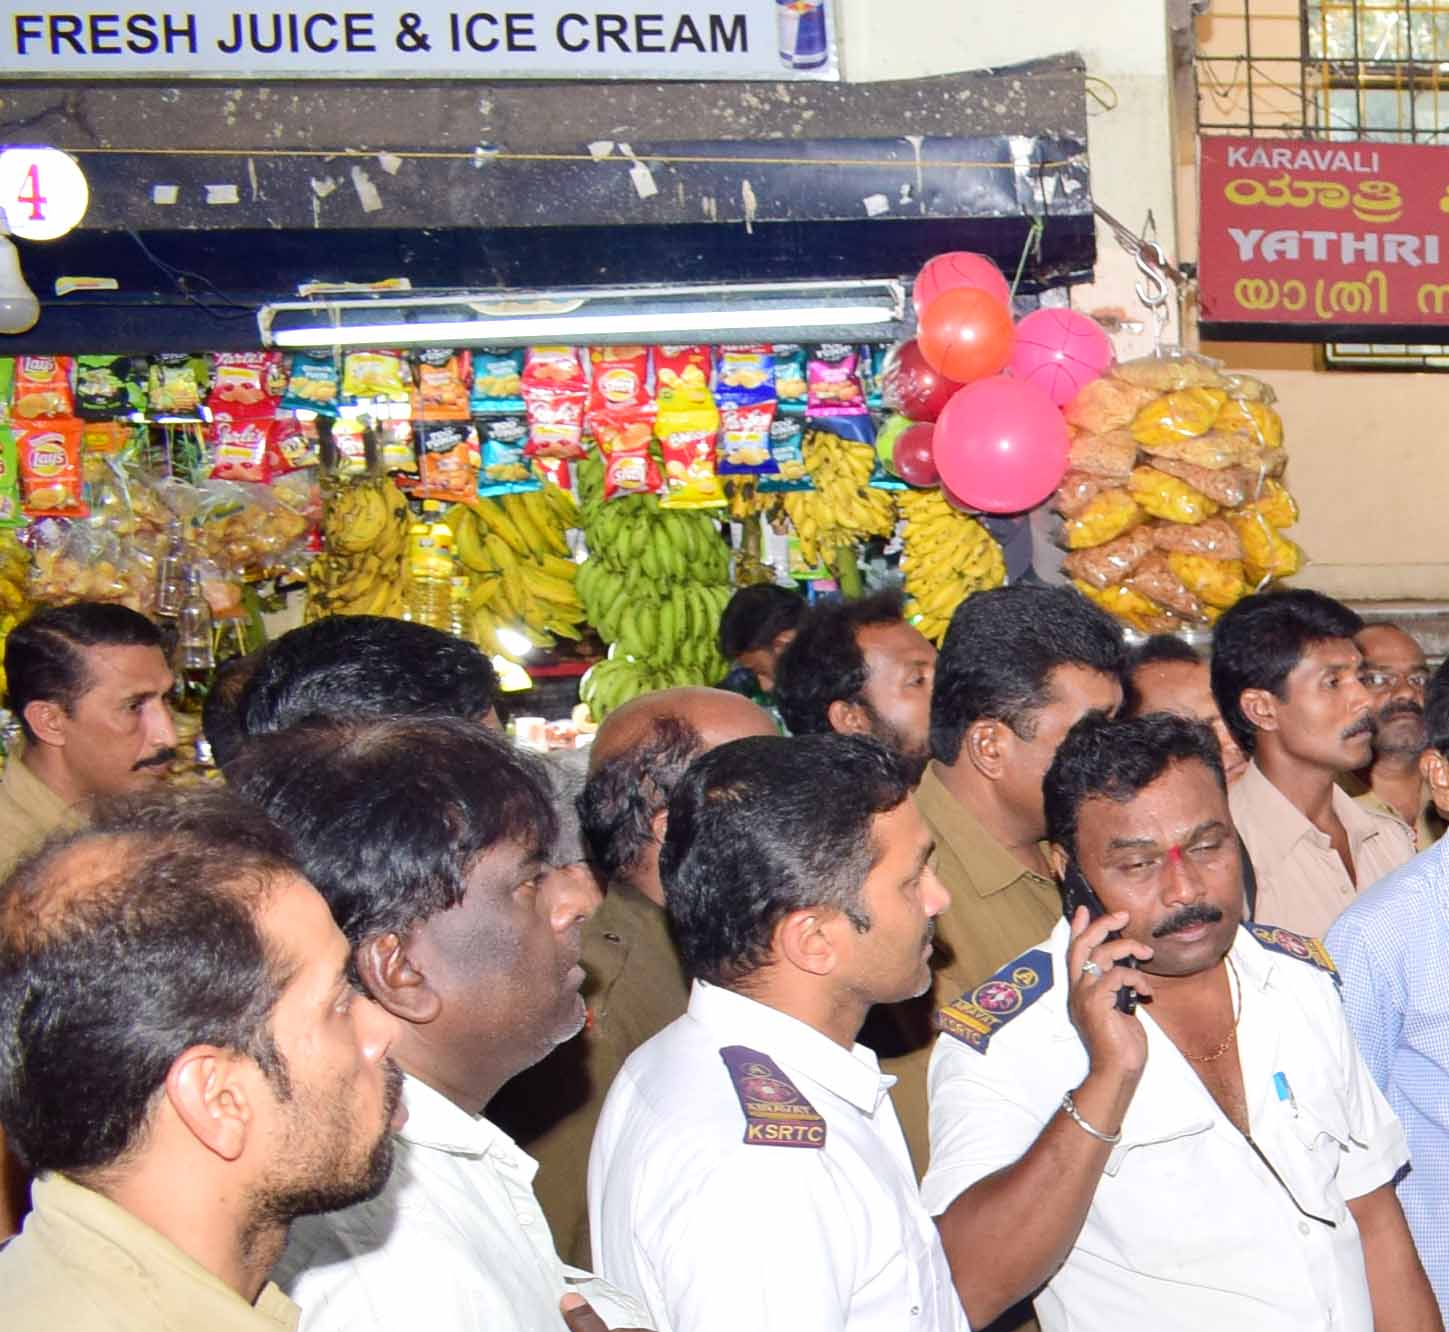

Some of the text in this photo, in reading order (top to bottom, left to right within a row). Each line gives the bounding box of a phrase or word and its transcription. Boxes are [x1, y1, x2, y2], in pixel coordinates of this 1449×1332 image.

[16, 13, 749, 54] FRESH JUICE & ICE CREAM
[1227, 146, 1379, 173] KARAVALI
[18, 164, 47, 220] 4
[1224, 174, 1403, 222] ಯಾತ್ರಿ
[1228, 229, 1439, 266] YATHRI
[747, 1123, 823, 1142] KSRTC
